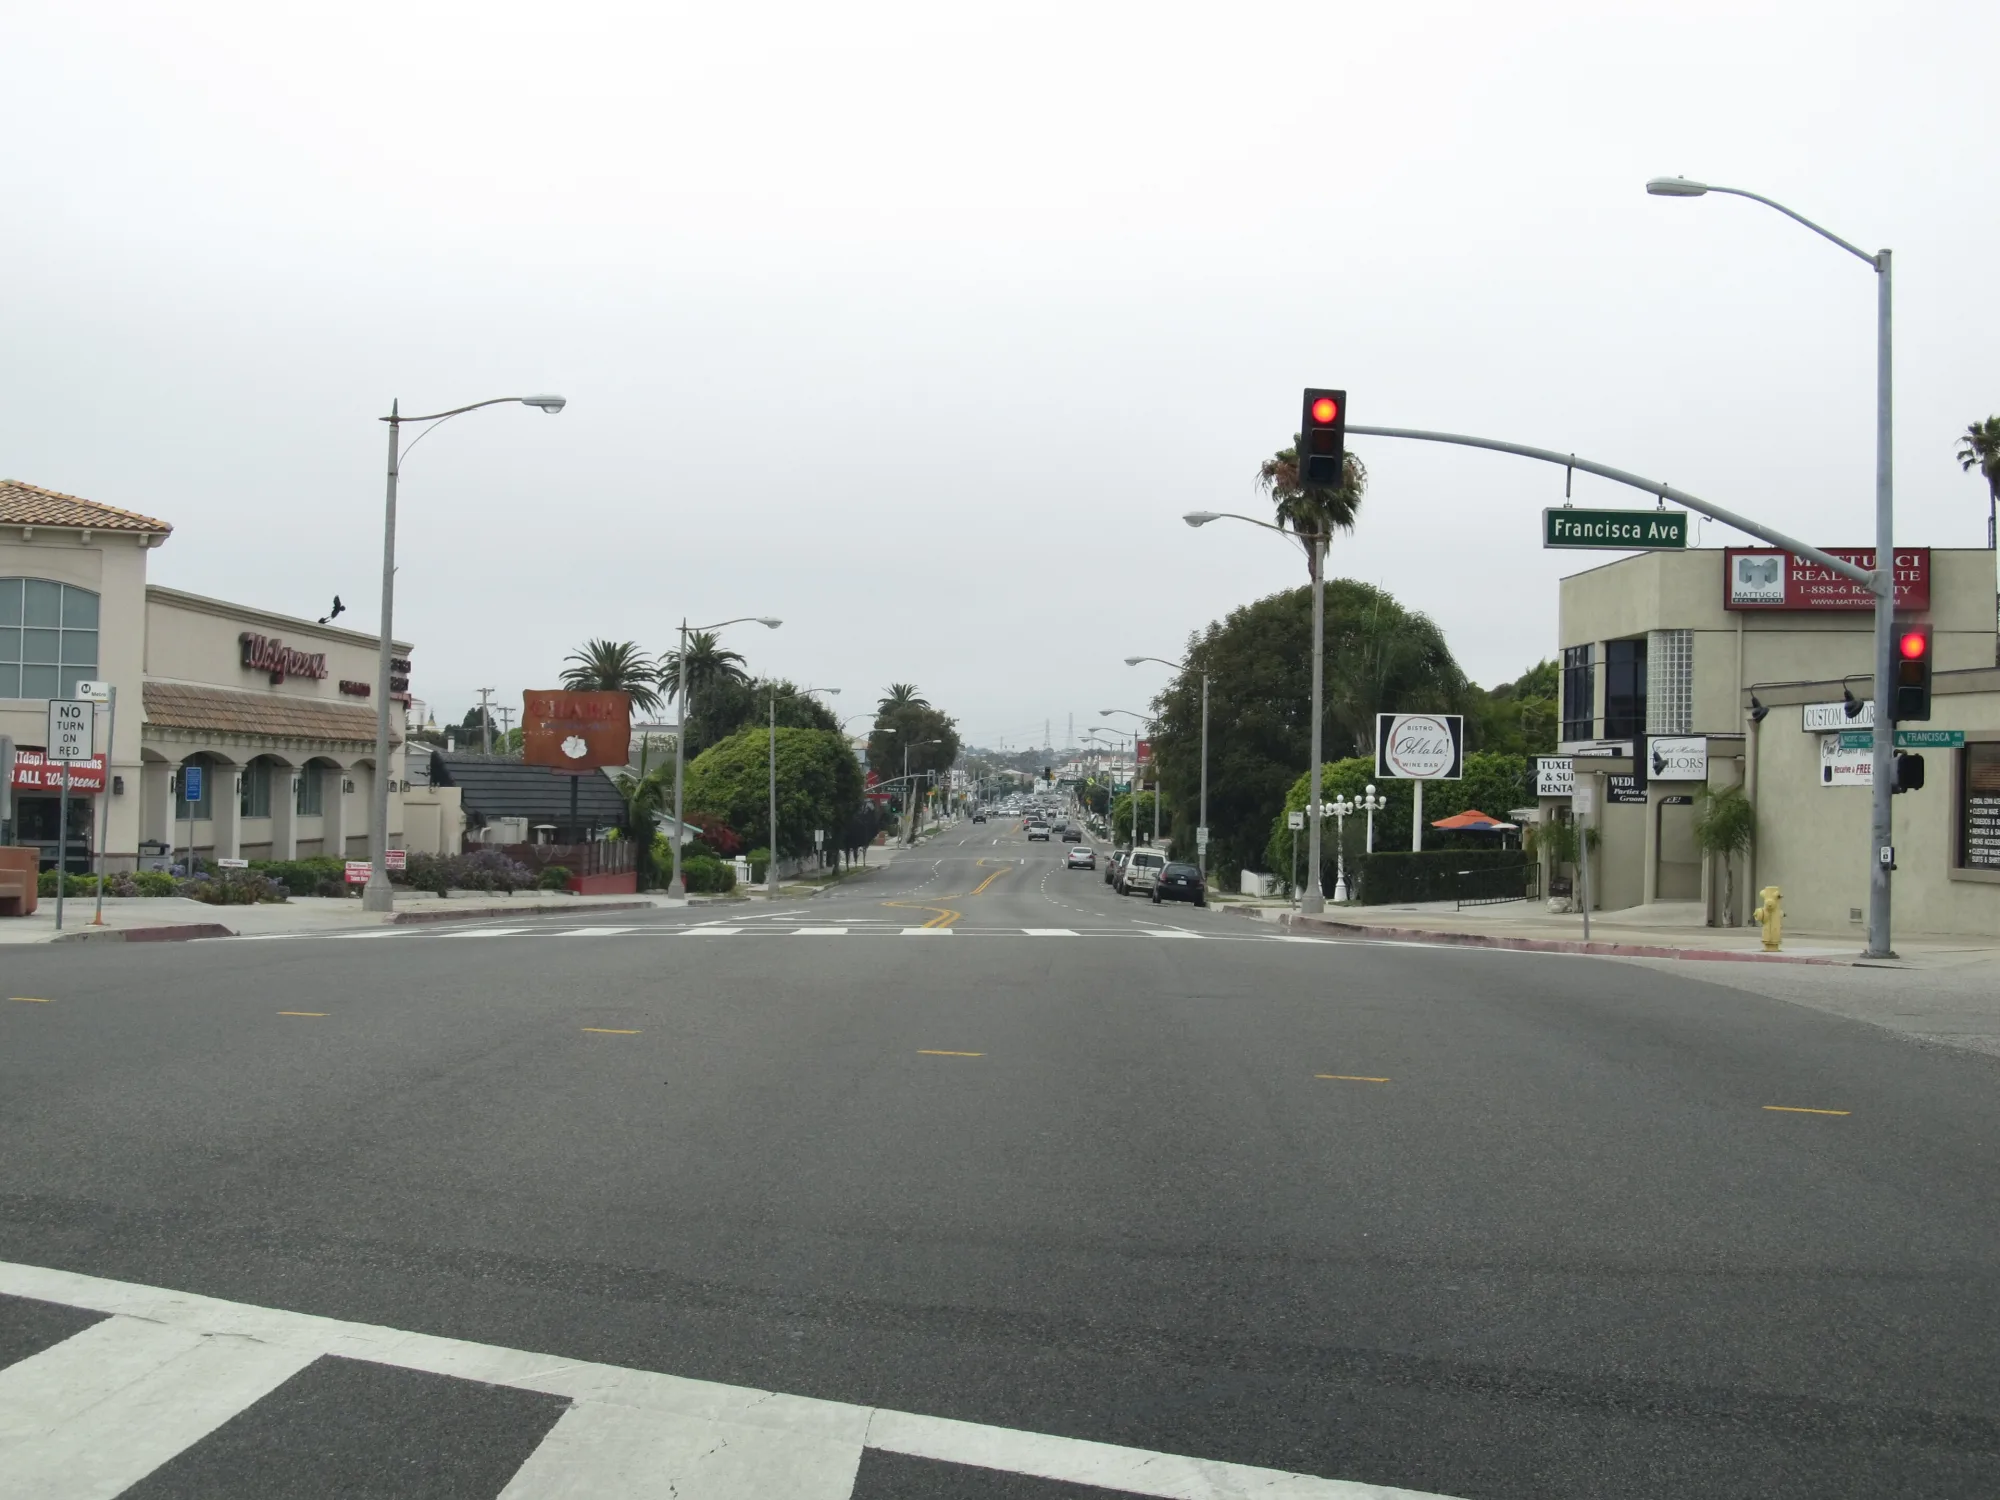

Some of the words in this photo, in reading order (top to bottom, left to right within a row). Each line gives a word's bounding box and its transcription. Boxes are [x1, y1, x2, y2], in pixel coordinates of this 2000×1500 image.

[1554, 518, 1641, 539] Francisca
[1648, 521, 1679, 540] Ave
[1792, 555, 1920, 567] MTUCI
[1792, 570, 1843, 581] REAL
[1800, 585, 1847, 595] 1-888-6
[240, 631, 329, 684] Walgreens
[60, 706, 81, 718] NO
[1806, 707, 1842, 727] CUSTOM
[57, 721, 85, 731] TURN
[62, 733, 77, 743] ON
[1907, 732, 1950, 742] FRANCISCA
[59, 746, 80, 756] RED
[15, 751, 44, 766] (Tdap)
[1834, 765, 1851, 774] Receive
[1856, 763, 1872, 774] FREE
[18, 769, 42, 785] ALL
[45, 772, 102, 791] Wagreens
[1544, 772, 1553, 782] &
[1540, 784, 1573, 793] RENTA
[1972, 807, 1988, 815] CUSTOM
[1971, 827, 1990, 835] RENTALS
[1971, 847, 1989, 855] CUSTOM
